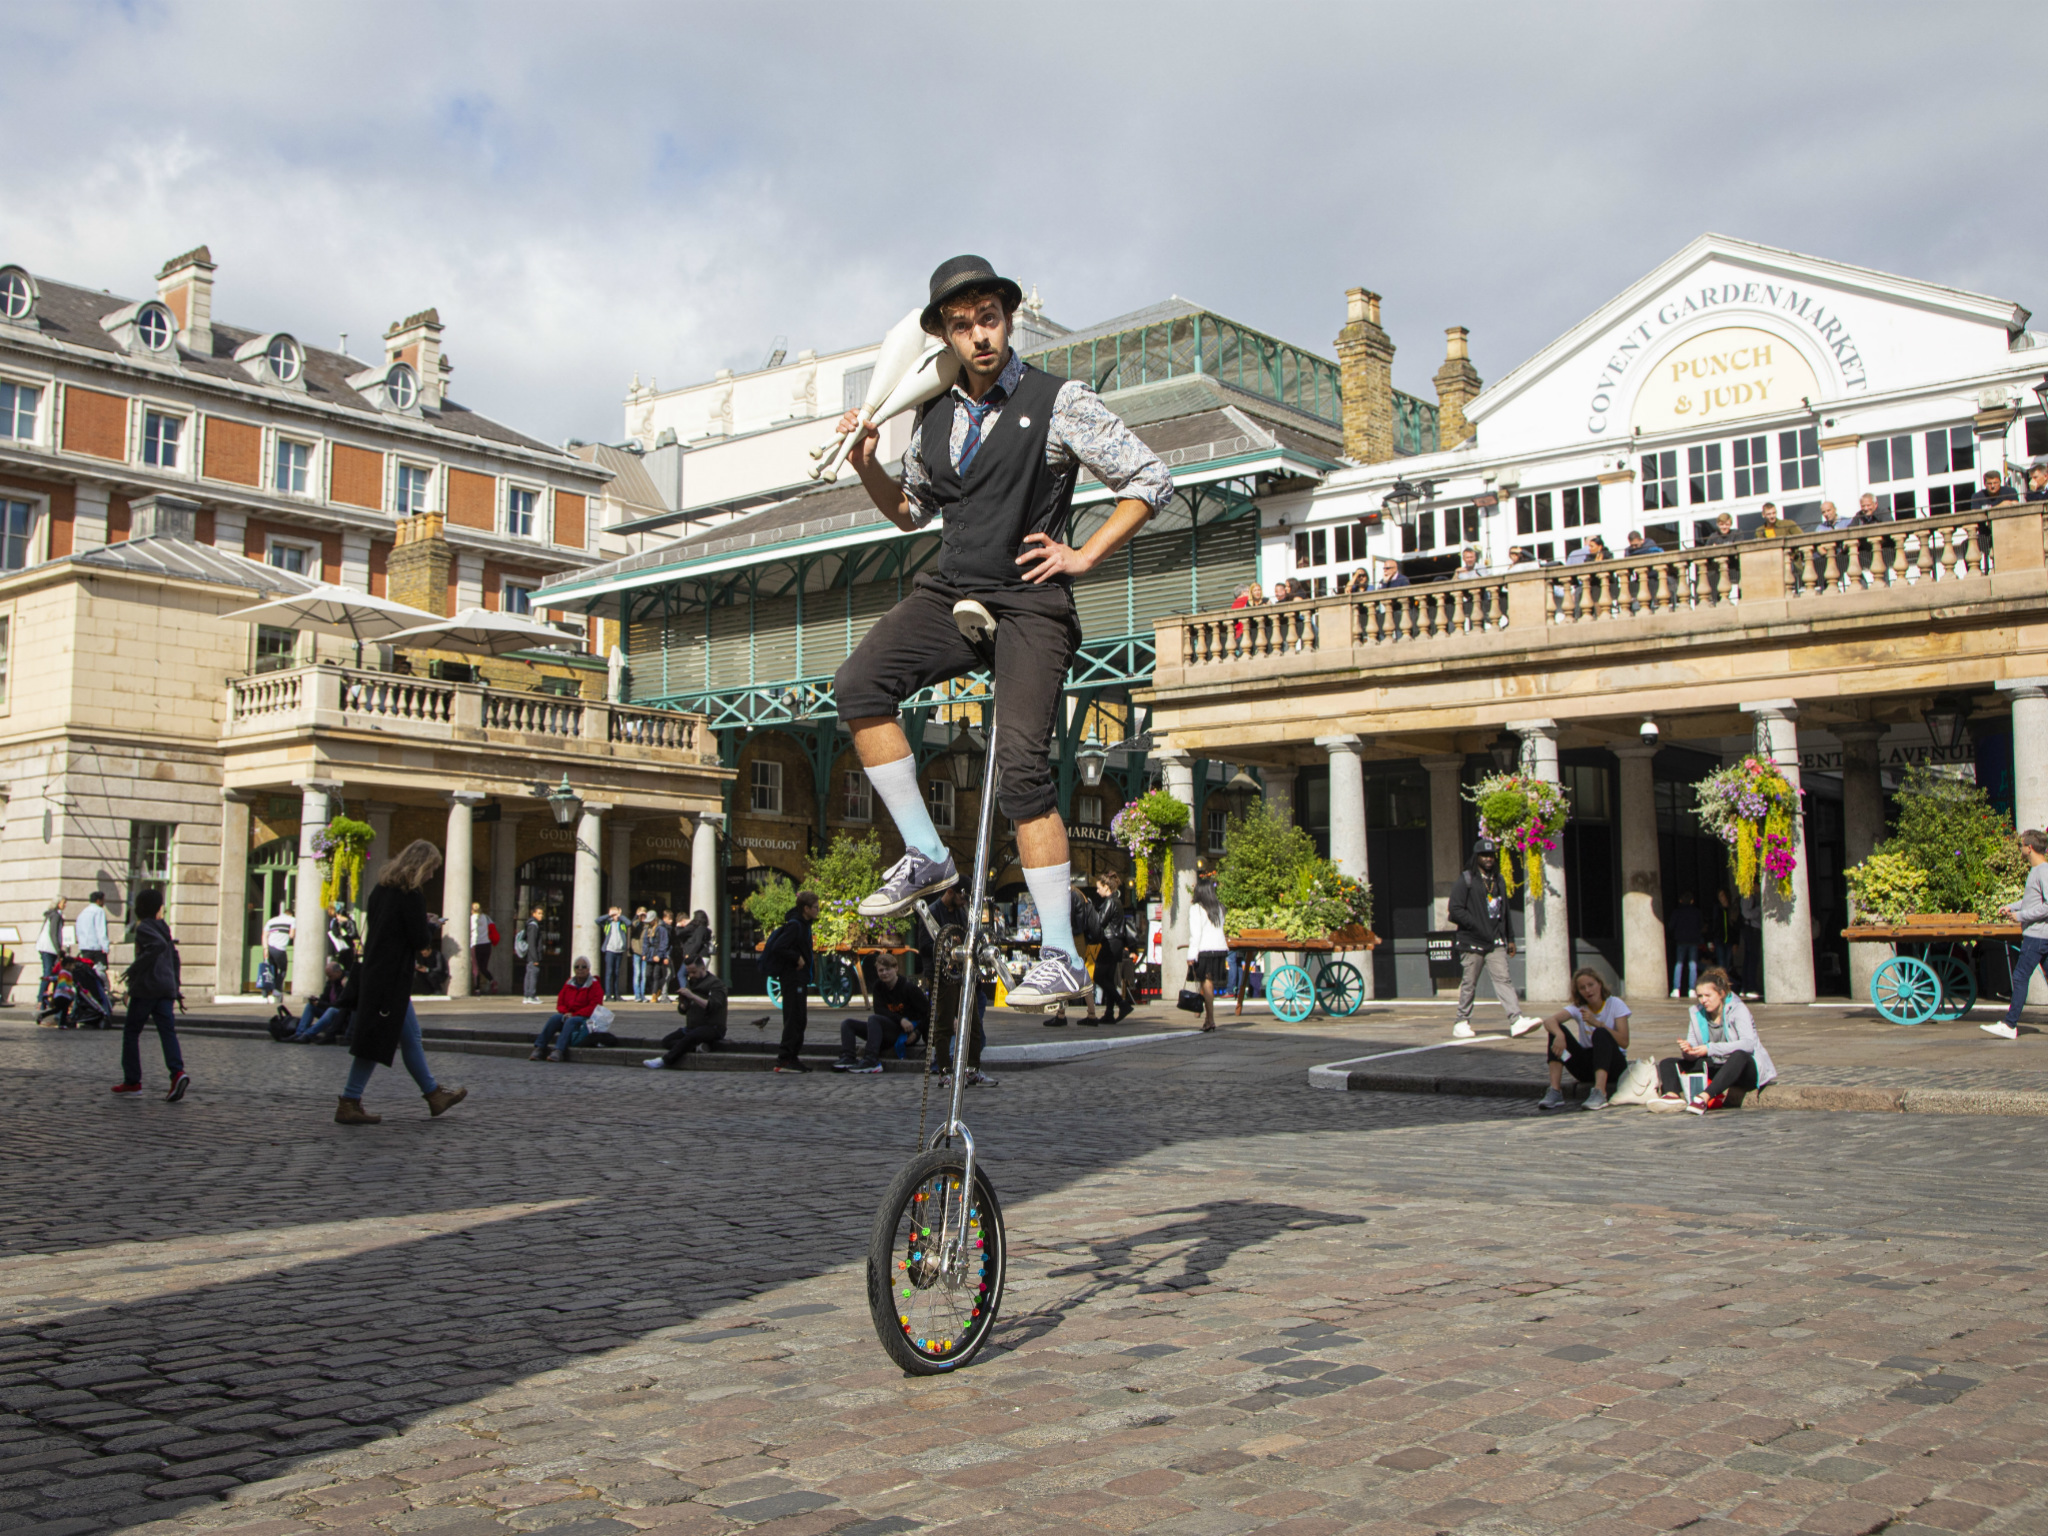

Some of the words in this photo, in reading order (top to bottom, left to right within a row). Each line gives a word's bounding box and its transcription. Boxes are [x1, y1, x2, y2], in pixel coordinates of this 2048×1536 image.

[1588, 321, 1652, 434] COVENT
[1658, 283, 1783, 326] GARDEN
[1782, 290, 1867, 391] MARKET
[1671, 345, 1773, 383] PUNCH
[1673, 395, 1693, 415] &
[1699, 378, 1774, 415] JUDY
[539, 828, 577, 841] GODIV
[646, 836, 690, 850] GODIVA
[1428, 940, 1453, 948] LITTER
